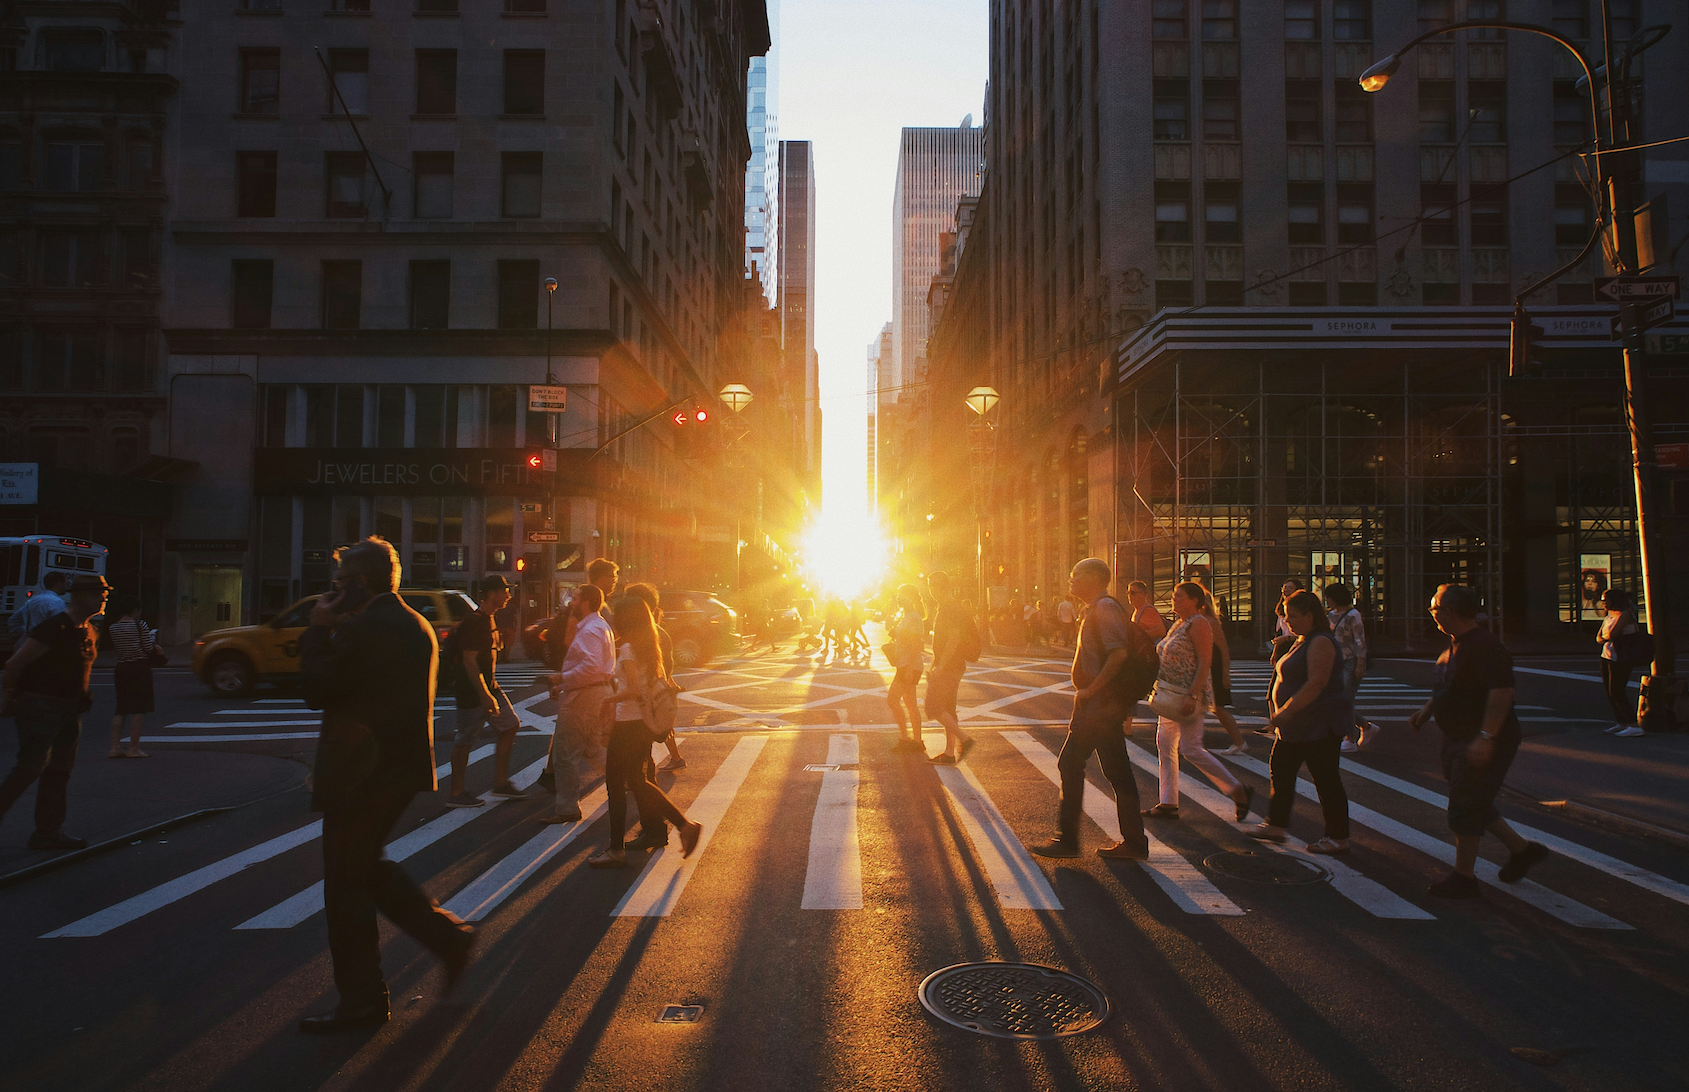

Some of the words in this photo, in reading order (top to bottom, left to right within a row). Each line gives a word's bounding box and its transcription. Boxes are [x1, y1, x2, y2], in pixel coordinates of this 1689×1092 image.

[1610, 284, 1633, 294] ONE
[1644, 284, 1670, 294] WAY
[1647, 304, 1667, 321] WAY
[1327, 322, 1377, 331] SEPHORA
[1553, 321, 1603, 330] SEPHORA
[1665, 336, 1675, 352] 5
[307, 459, 420, 485] JEWELERS
[429, 463, 469, 485] ON
